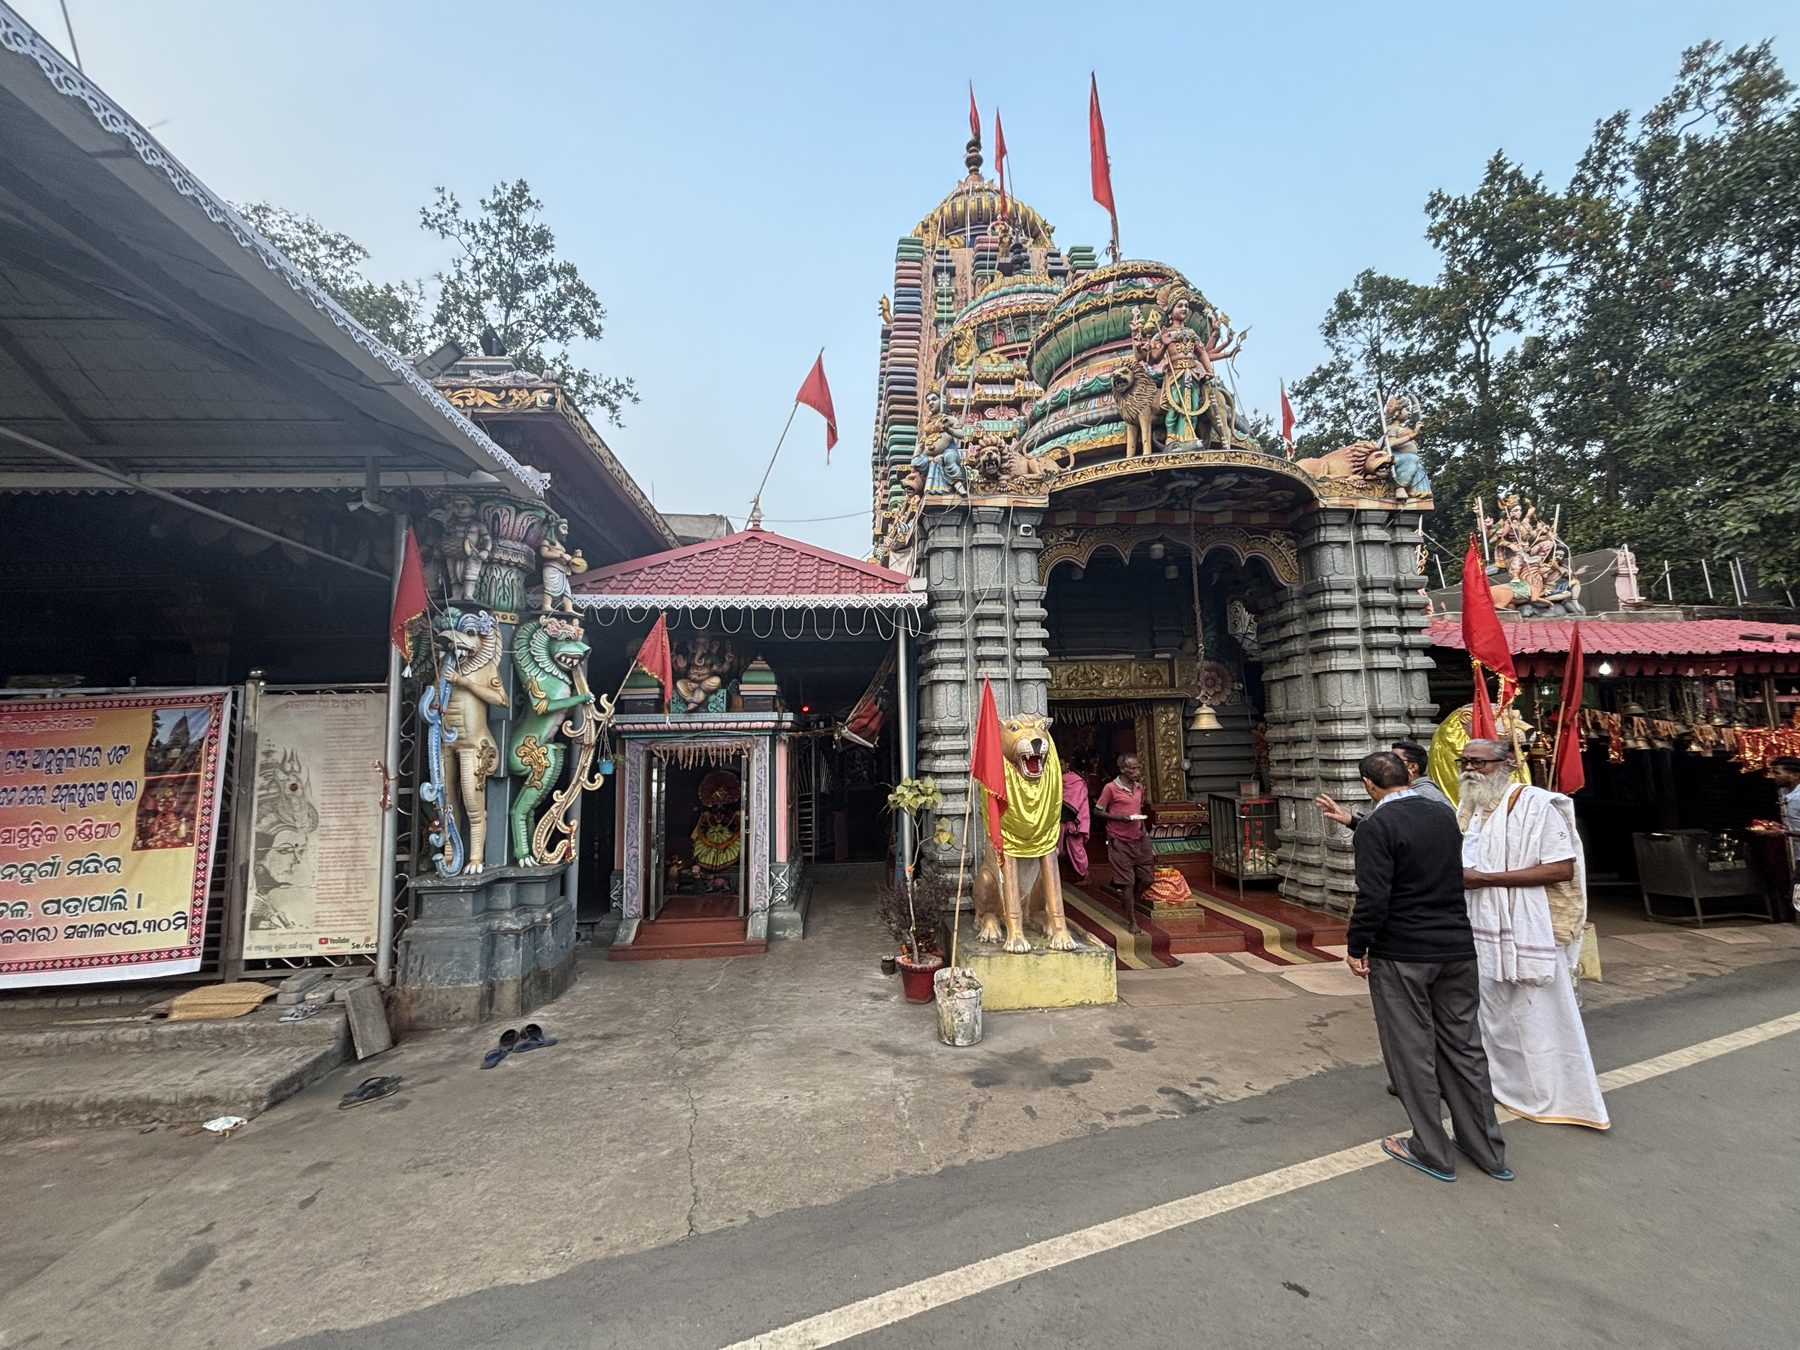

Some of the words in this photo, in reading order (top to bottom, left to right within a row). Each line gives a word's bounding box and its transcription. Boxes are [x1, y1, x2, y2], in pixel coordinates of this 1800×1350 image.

[0, 854, 62, 884] ନଦୁର୍ଗା
[66, 852, 123, 877] ମନ୍ଦିର
[0, 925, 59, 945] ଳବାର)
